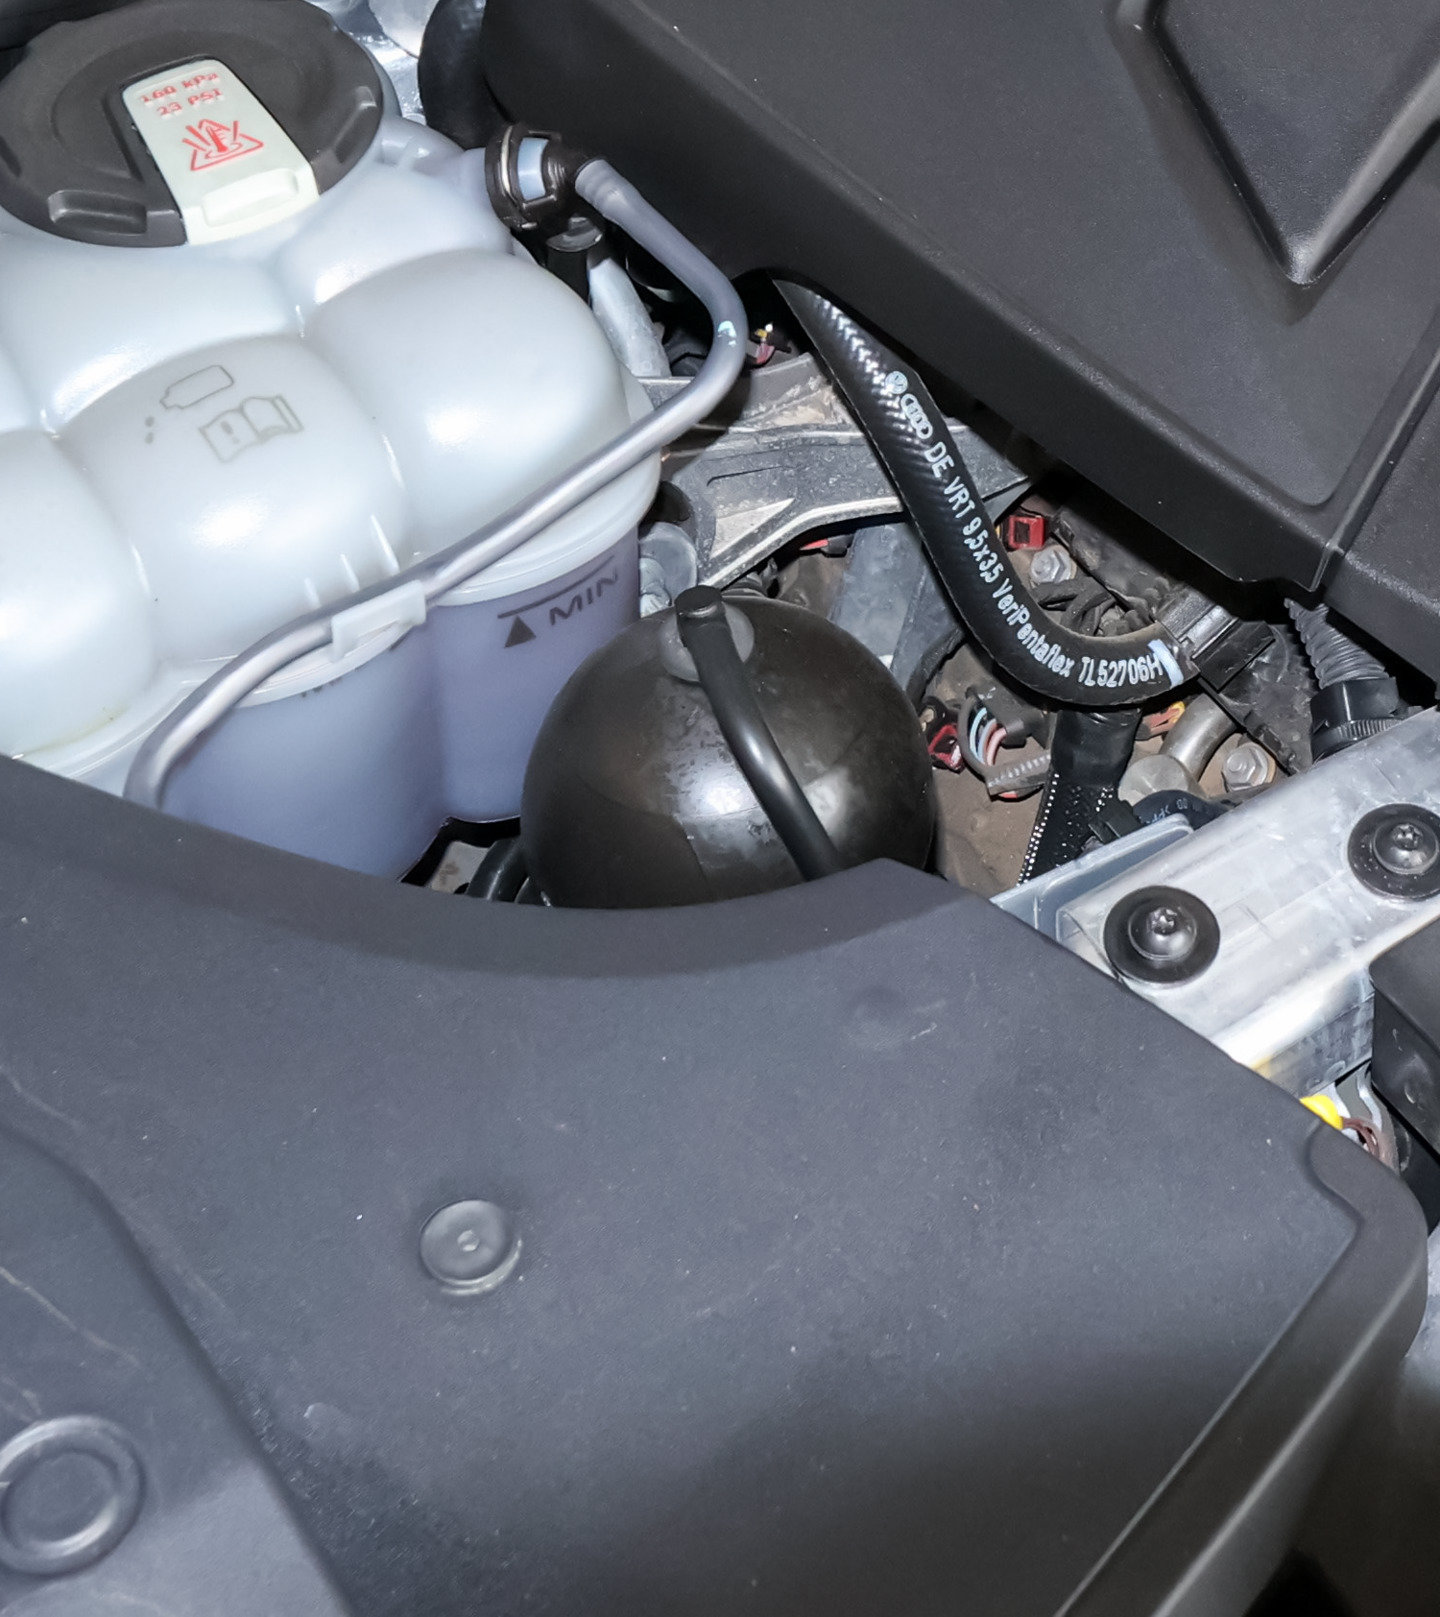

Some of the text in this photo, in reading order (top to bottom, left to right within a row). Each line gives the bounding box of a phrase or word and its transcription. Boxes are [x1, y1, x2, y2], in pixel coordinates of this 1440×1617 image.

[140, 73, 218, 103] 160 kPa
[156, 88, 222, 115] 23 PSI
[924, 441, 1163, 688] DE VRT 9,5x3,5 VeriPentaflex TL52706H
[549, 566, 619, 626] MIN
